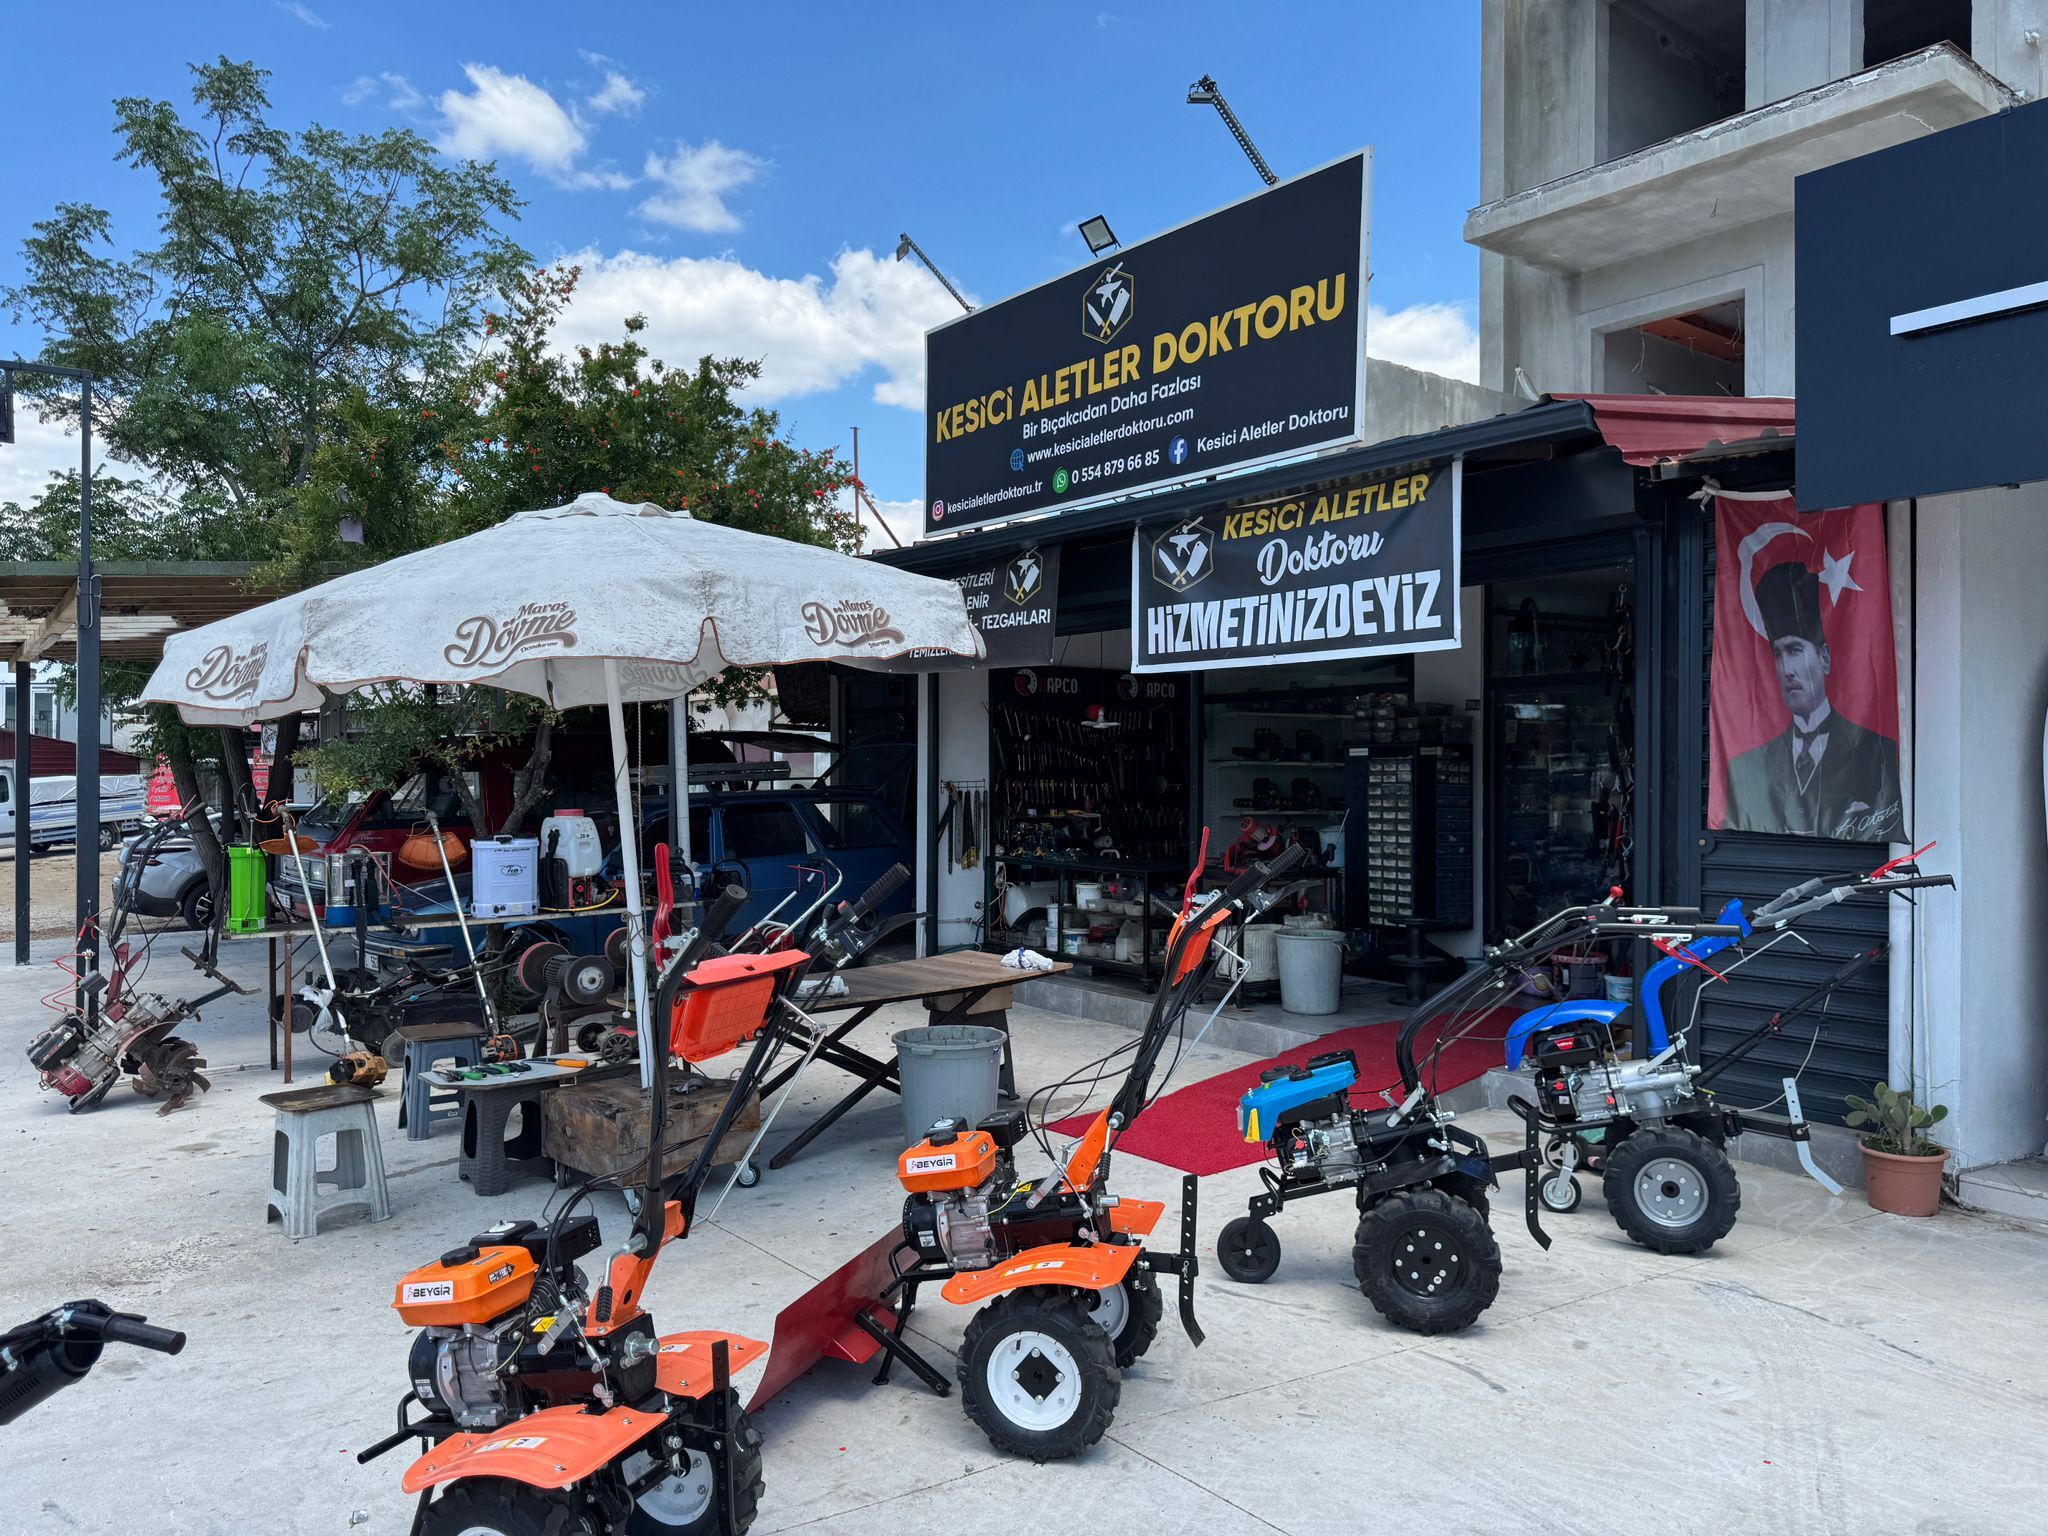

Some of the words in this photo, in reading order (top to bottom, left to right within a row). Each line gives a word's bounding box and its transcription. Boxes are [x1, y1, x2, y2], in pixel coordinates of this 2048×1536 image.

[937, 386, 1013, 443] KESİCİ
[1020, 344, 1140, 416] ALETLER
[1153, 273, 1345, 374] DOKTORU
[1023, 421, 1038, 440] Bir
[1041, 403, 1107, 435] Bıçakcıdan
[1111, 391, 1147, 414] Daha
[1151, 375, 1201, 401] Fazlası
[1197, 430, 1236, 453] Kesici
[1239, 419, 1285, 443] Aletler
[1289, 406, 1348, 430] Doktoru
[1027, 408, 1194, 463] www.kesicialetlerdoktoru.com
[1071, 470, 1079, 484] 0
[1081, 464, 1101, 482] 554
[1104, 459, 1124, 476] 879
[1127, 455, 1142, 471] 66
[1145, 450, 1160, 466] 85
[947, 480, 1043, 514] kesicialetlerdoktoru.tr
[1222, 501, 1305, 541] KESİCİ
[1309, 474, 1430, 525] ALETLER
[1257, 530, 1384, 586] Doktoru
[517, 601, 570, 617] Maraş
[981, 609, 1051, 630] TEZGAHLARI
[444, 609, 578, 668] Dövme
[913, 1157, 953, 1169] BEYGİR
[413, 1284, 451, 1299] BEYGİR
